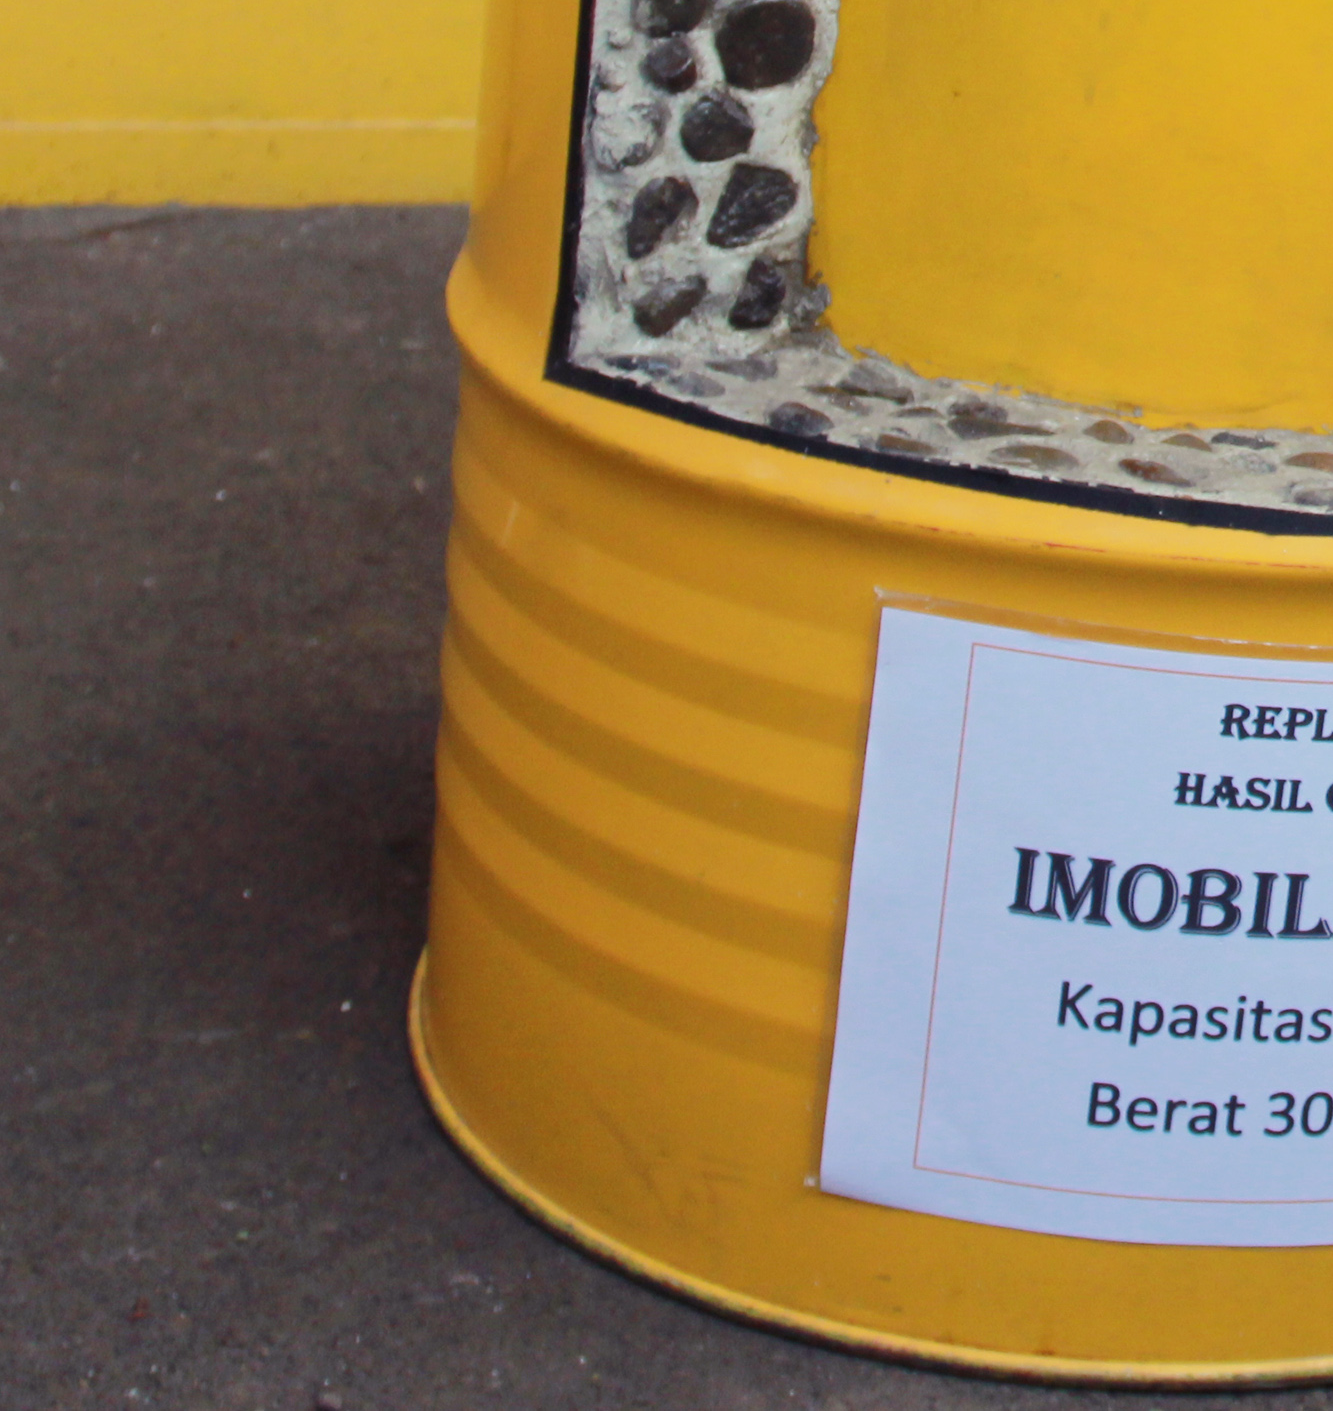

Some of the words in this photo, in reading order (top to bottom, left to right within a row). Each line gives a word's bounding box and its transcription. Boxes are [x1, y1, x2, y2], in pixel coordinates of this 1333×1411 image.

[1175, 772, 1313, 813] HASIL
[1057, 980, 1333, 1047] Kapasitas
[1087, 1081, 1246, 1137] Berat
